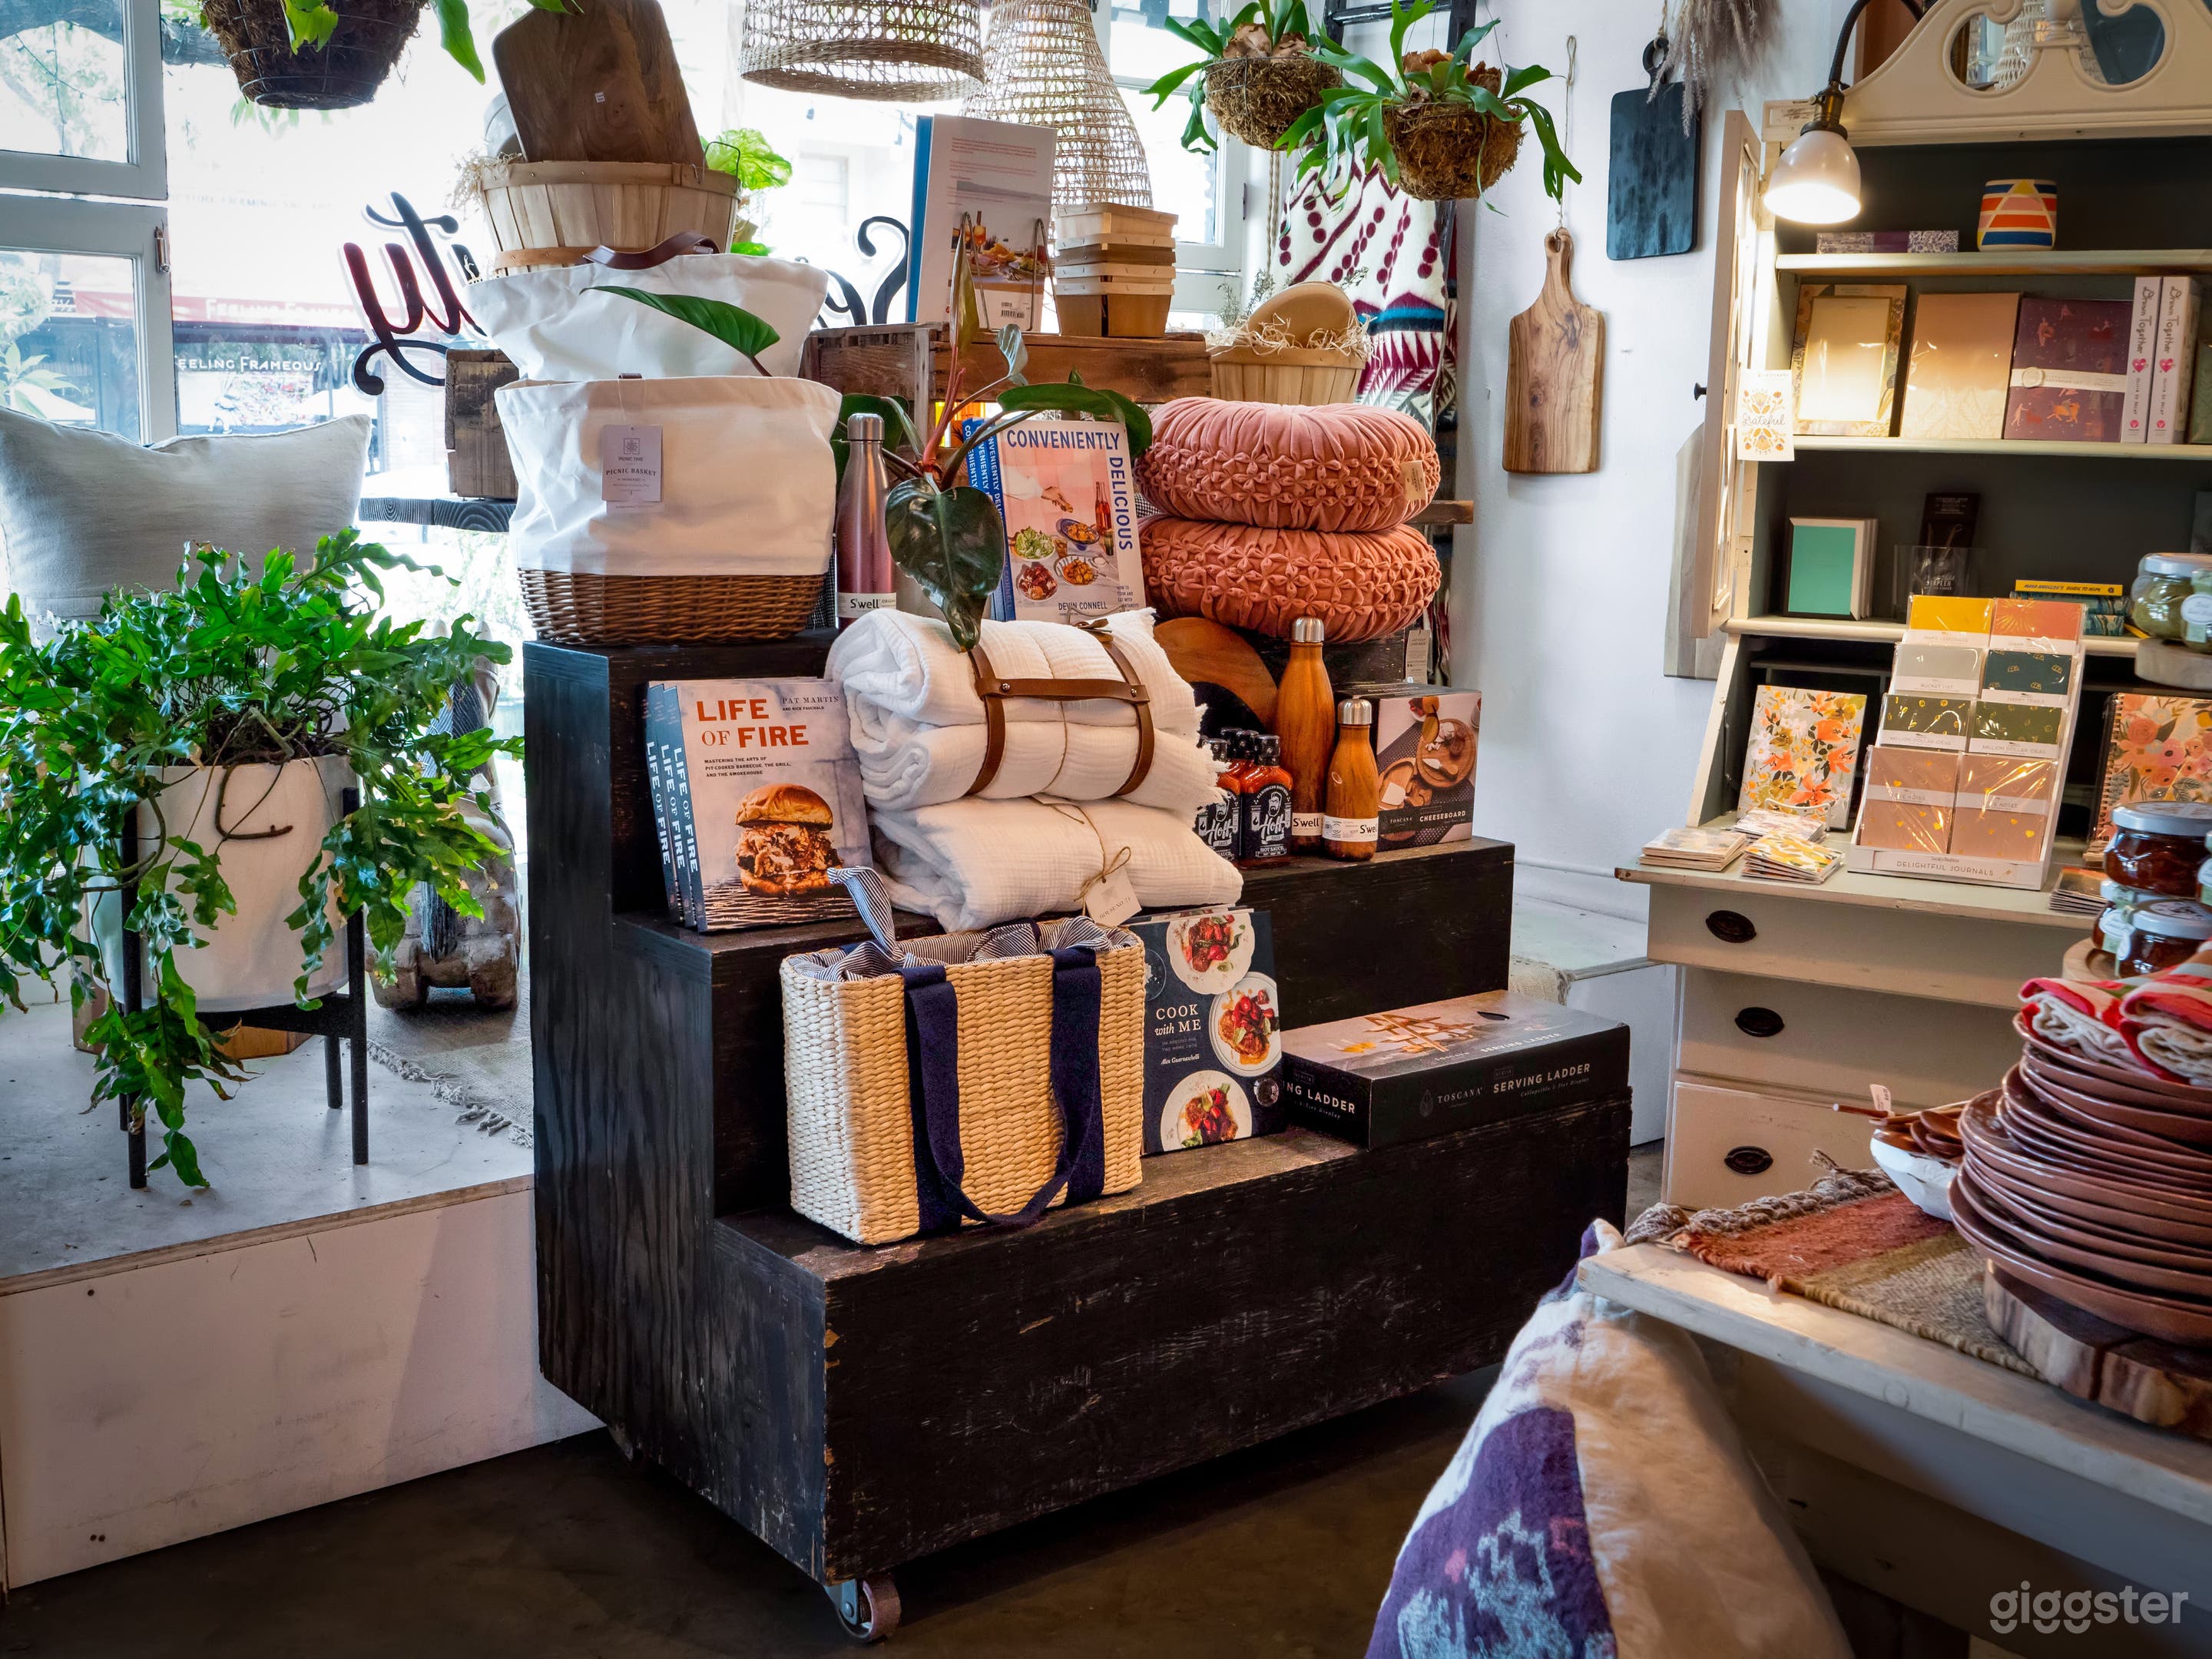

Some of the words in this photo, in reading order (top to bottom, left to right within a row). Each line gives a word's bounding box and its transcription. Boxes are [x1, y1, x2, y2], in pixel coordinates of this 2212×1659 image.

[177, 358, 235, 372] EELING
[1006, 429, 1120, 451] CONVENIENTLY
[965, 425, 979, 488] COENIENTLY
[631, 468, 657, 477] BASKET
[1109, 456, 1133, 551] DELICIOUS
[1079, 601, 1108, 610] CONNELL
[696, 698, 770, 722] LIFE
[782, 697, 800, 705] PAT
[803, 695, 839, 704] MARTIN
[701, 730, 730, 747] OF
[737, 724, 810, 749] FIRE
[647, 740, 661, 790] LIFE
[661, 743, 676, 793] LIFE
[674, 747, 688, 796] LIFE
[655, 793, 663, 813] OF
[669, 796, 677, 816] OF
[682, 800, 691, 820] OF
[1419, 810, 1466, 823] CHEESEBOARD
[657, 816, 671, 866] FIRE
[671, 820, 686, 869] FIRE
[685, 823, 698, 873] FIRE
[1896, 861, 1946, 871] DELIGHTFUL
[1950, 866, 1994, 876] JOURNALS
[1155, 1004, 1199, 1021] COOK
[1154, 1022, 1174, 1036] with
[1178, 1018, 1201, 1034] ME
[1480, 1041, 1522, 1053] SERVING
[1523, 1031, 1562, 1043] LADDER
[1438, 1088, 1482, 1104] TOSCANA
[1493, 1074, 1543, 1094] SERVING
[1547, 1063, 1591, 1082] LADDER
[1307, 1088, 1355, 1114] LADDER
